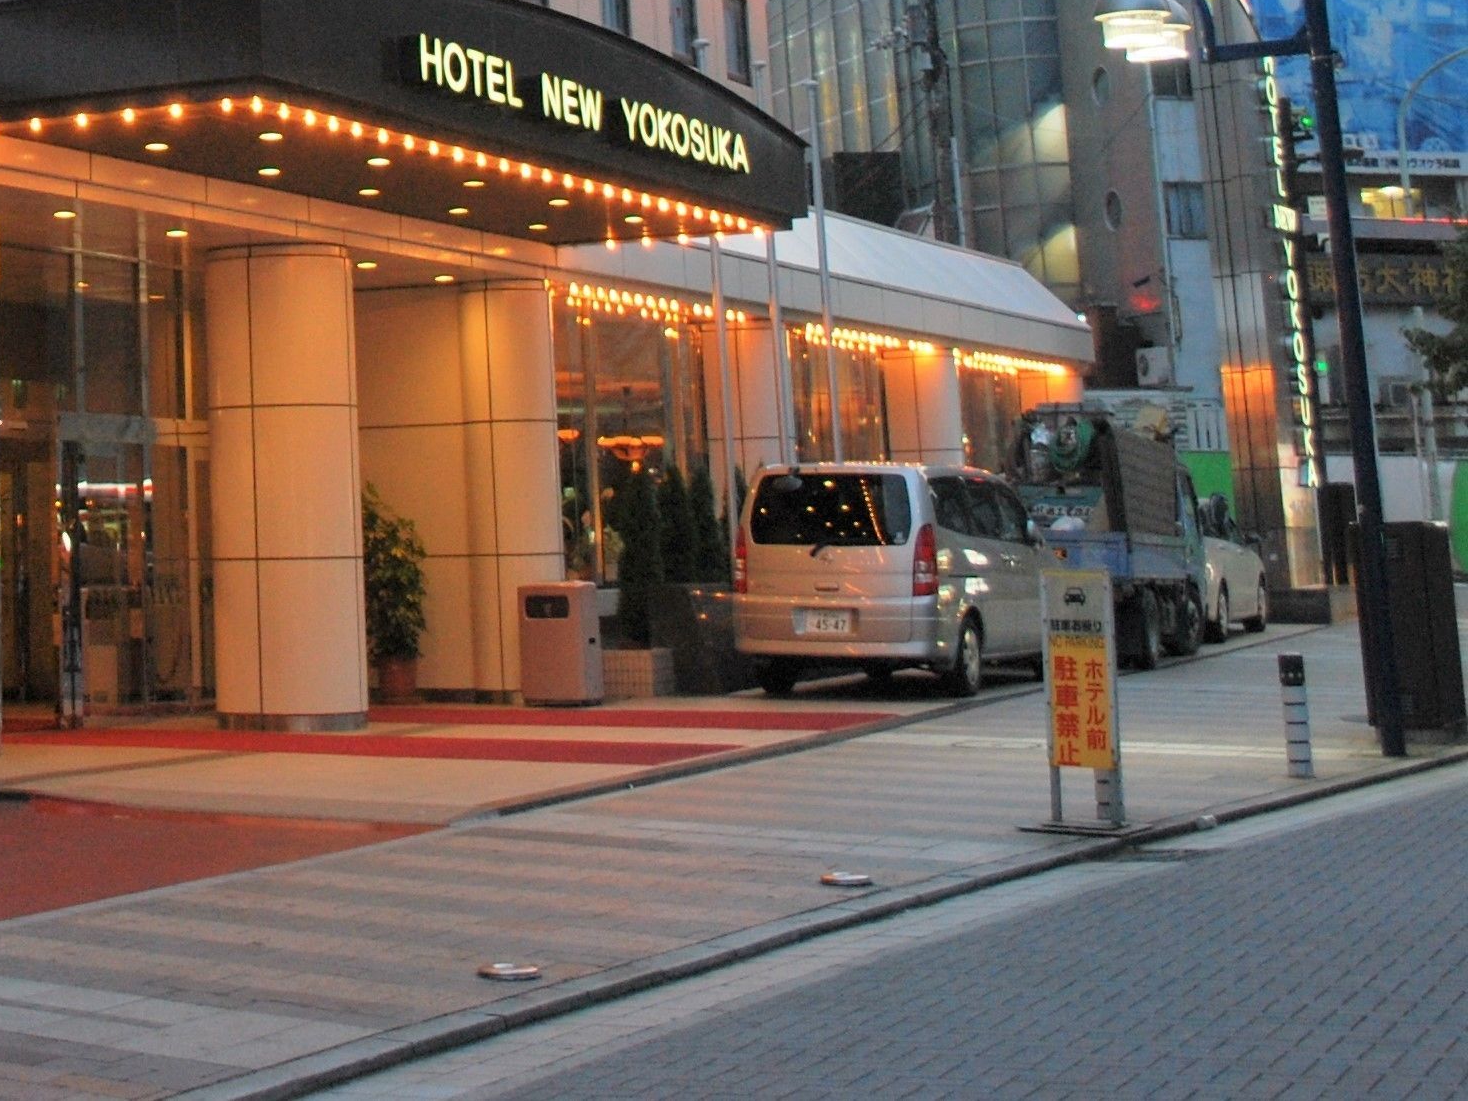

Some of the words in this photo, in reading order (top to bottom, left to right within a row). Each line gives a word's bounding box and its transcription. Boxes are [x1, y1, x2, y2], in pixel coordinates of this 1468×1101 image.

[419, 32, 524, 109] HOTEL
[541, 72, 603, 132] NEW
[620, 96, 751, 175] YOKOSUKA
[1282, 238, 1320, 488] YOKOSUKA
[1054, 655, 1082, 768] 駐車禁止
[1084, 657, 1108, 751] ホテル前
